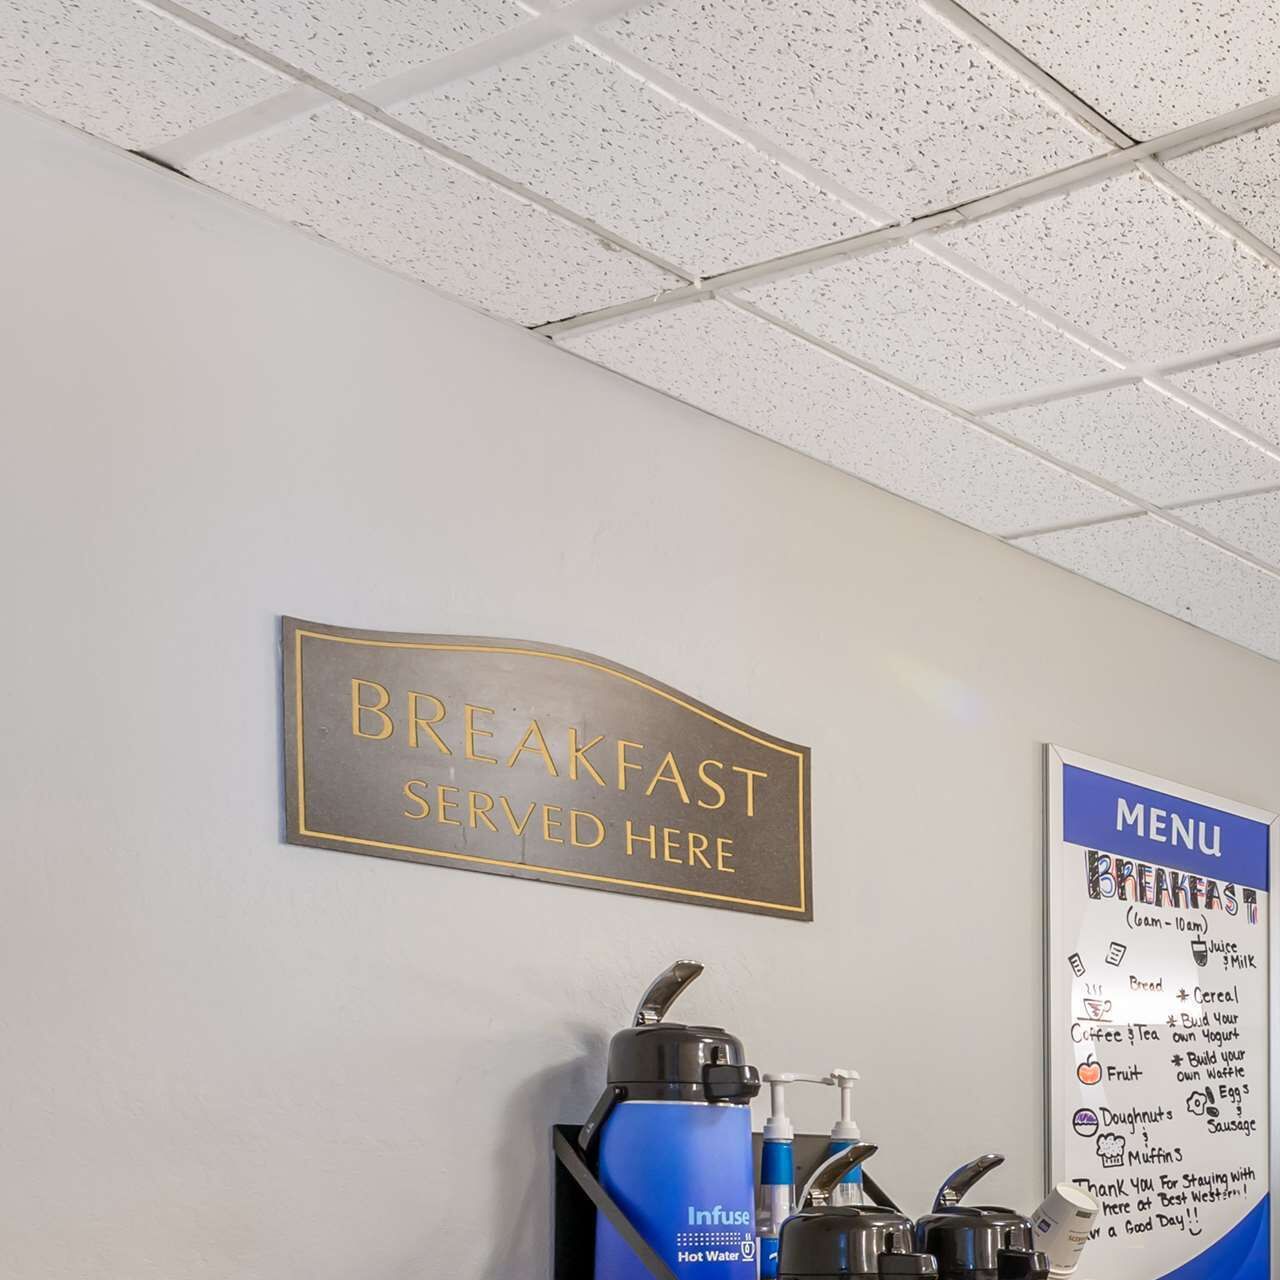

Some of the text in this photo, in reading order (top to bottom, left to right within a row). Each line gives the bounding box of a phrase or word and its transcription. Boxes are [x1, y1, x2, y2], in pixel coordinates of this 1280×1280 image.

[351, 678, 769, 818] BREAKFAST
[403, 778, 736, 874] SERVED HERE
[1116, 797, 1222, 858] MENU
[1085, 850, 1258, 925] BREAKFAST
[1208, 940, 1238, 953] Juice
[1129, 976, 1164, 993] Bread
[1194, 985, 1239, 1004] Cereal
[1070, 1022, 1123, 1043] Coffee
[1134, 1023, 1160, 1041] Tea
[1187, 1050, 1218, 1067] Build
[1107, 1065, 1143, 1081] Fruit
[1219, 1084, 1250, 1104] Eggs
[1099, 1106, 1173, 1135] Doughnuts
[1207, 1118, 1257, 1137] Sausage
[1102, 1201, 1131, 1217] here
[1137, 1200, 1152, 1212] at
[1158, 1191, 1188, 1208] Best
[688, 1205, 751, 1226] Infuse
[1108, 1226, 1118, 1238] a
[1126, 1216, 1154, 1234] Good
[678, 1250, 740, 1263] Hot Water
